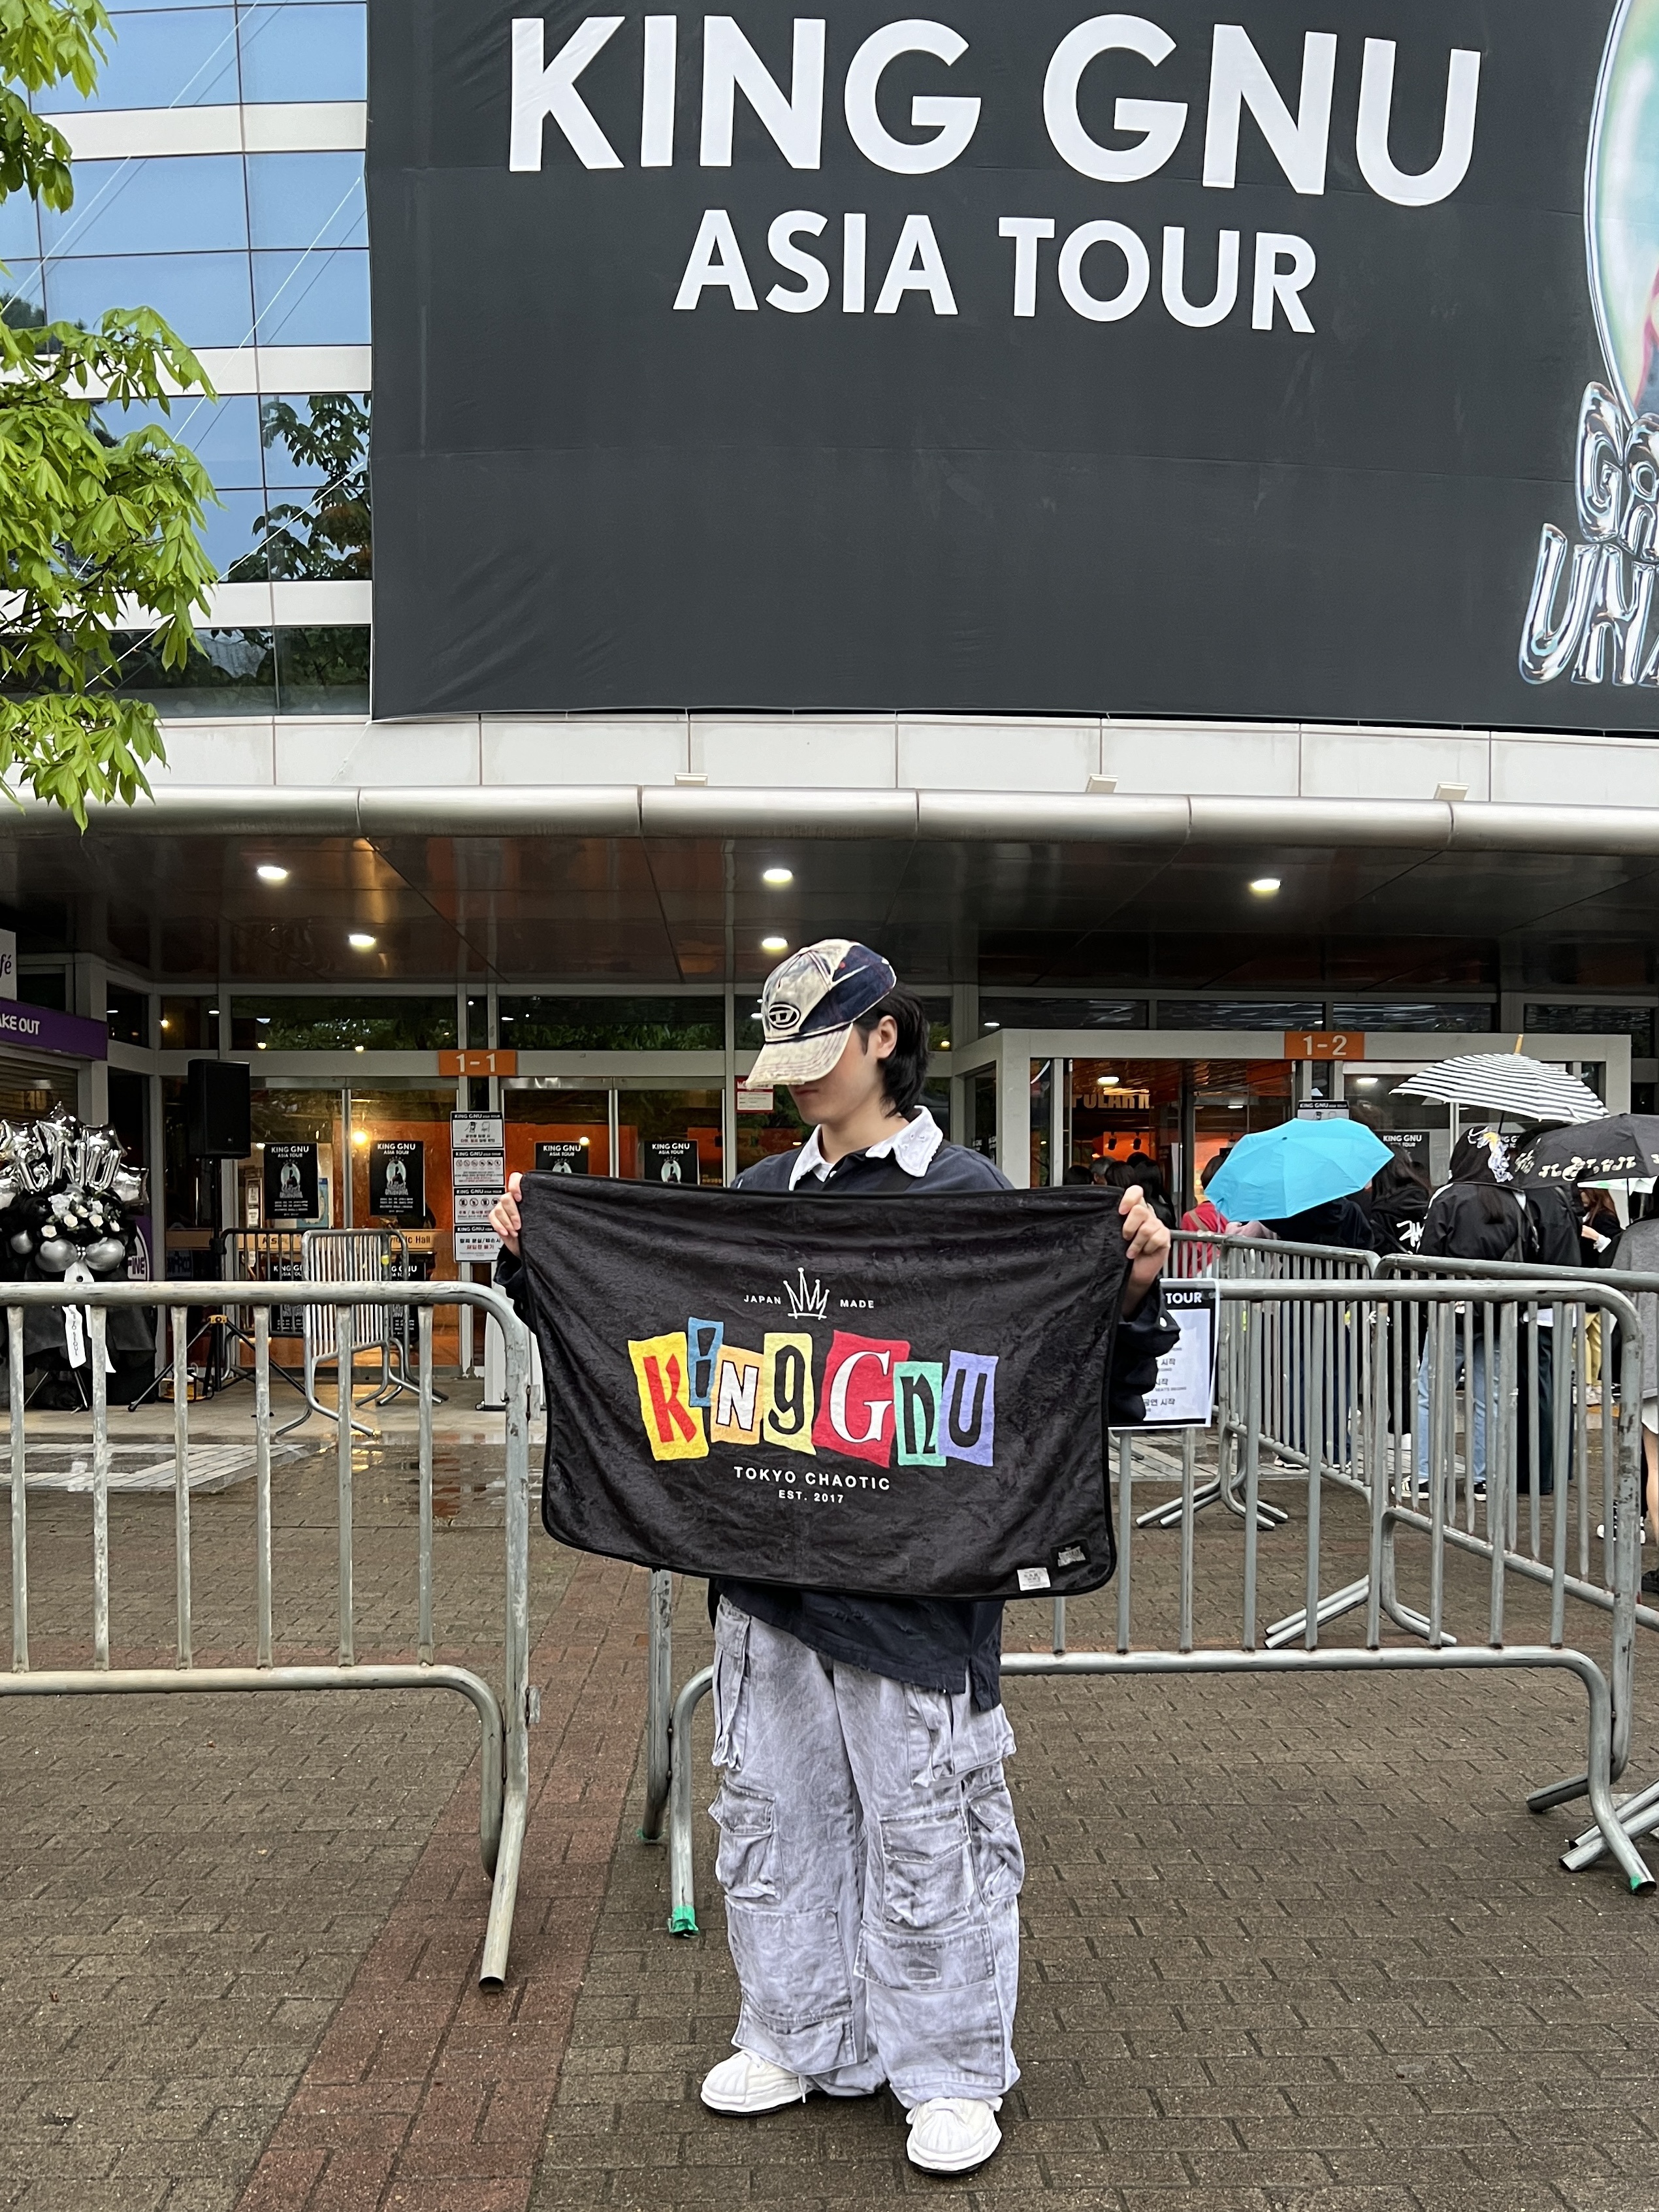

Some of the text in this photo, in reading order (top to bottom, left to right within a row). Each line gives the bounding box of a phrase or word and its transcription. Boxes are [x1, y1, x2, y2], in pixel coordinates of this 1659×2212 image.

[509, 14, 1481, 207] KING GNU
[673, 209, 1316, 334] ASIA TOUR
[19, 1018, 40, 1035] OUT
[1303, 1034, 1347, 1055] 1-2
[456, 1053, 495, 1072] 1-1
[743, 1294, 875, 1309] JAPAN MADE
[1165, 1292, 1202, 1304] TOUR
[733, 1466, 890, 1490] TOKYO CHAOTIC
[779, 1490, 844, 1503] EST. 2017
